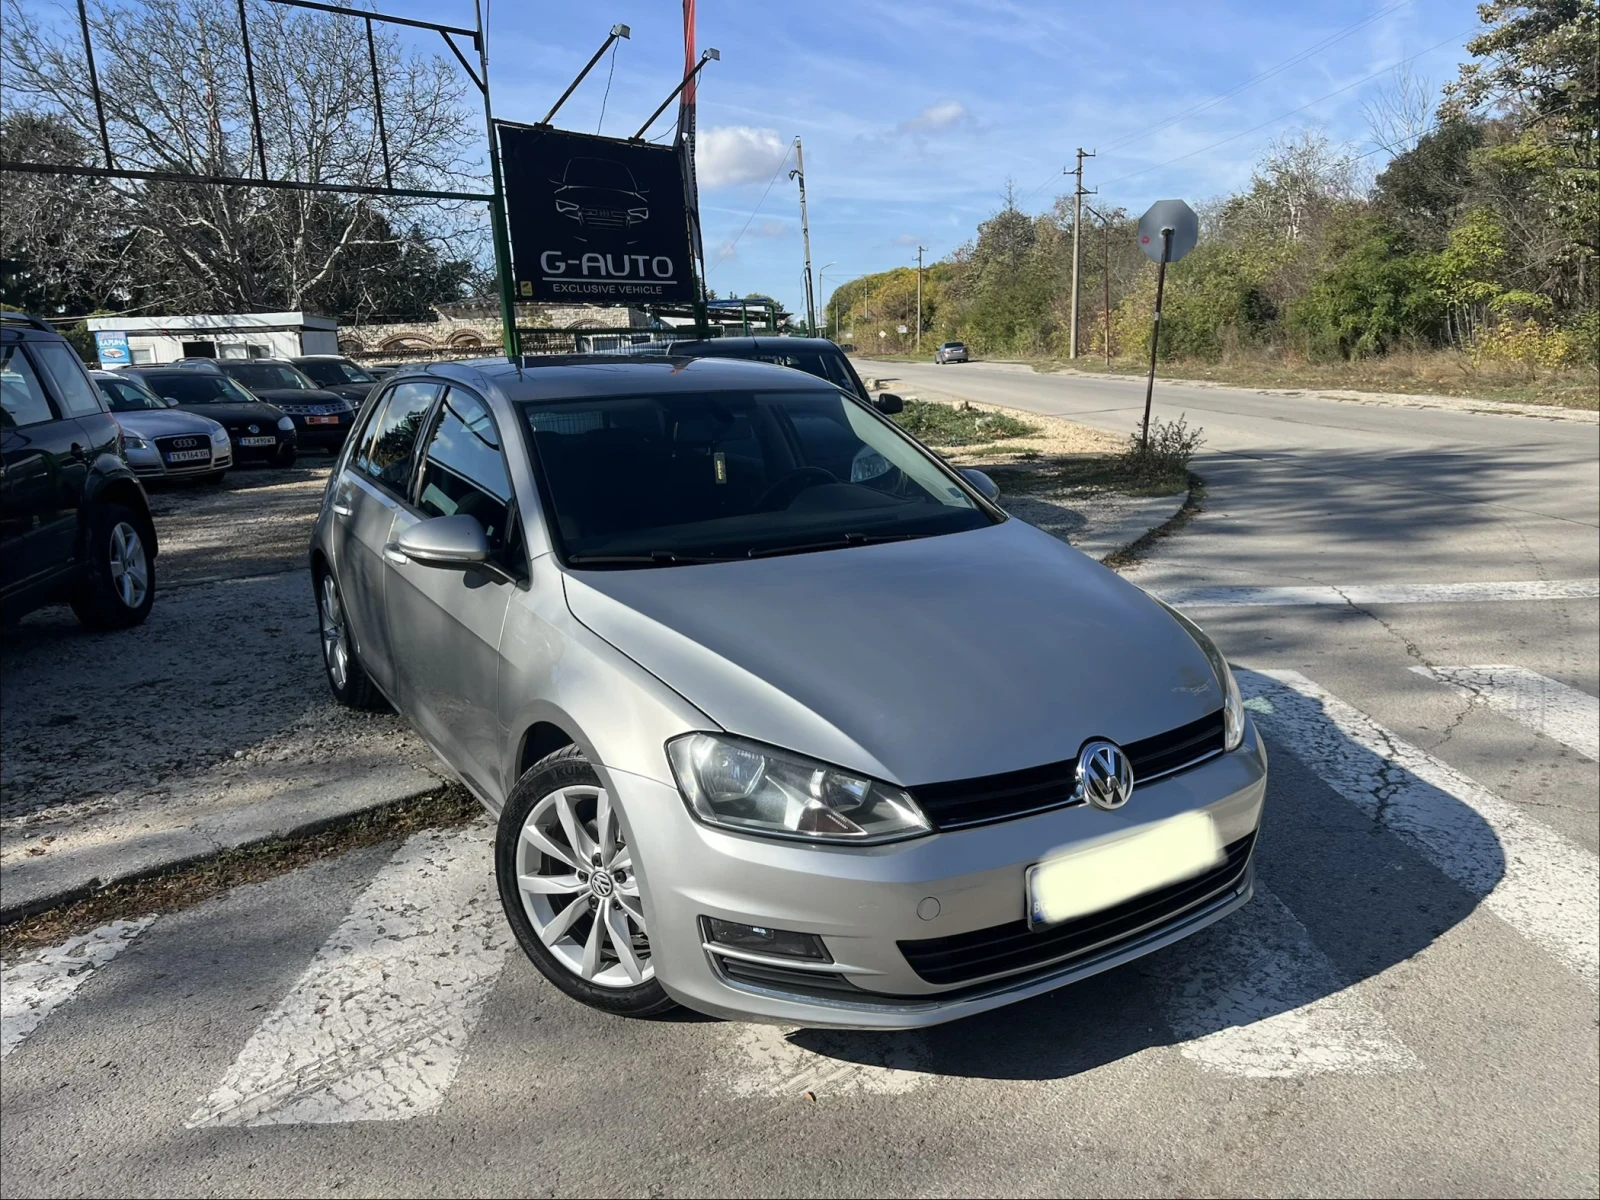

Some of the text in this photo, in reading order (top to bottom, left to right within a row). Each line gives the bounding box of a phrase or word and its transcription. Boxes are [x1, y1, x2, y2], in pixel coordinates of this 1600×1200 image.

[540, 250, 674, 278] G-AUTO
[552, 283, 663, 295] EXCLUSIVE VEHICLE
